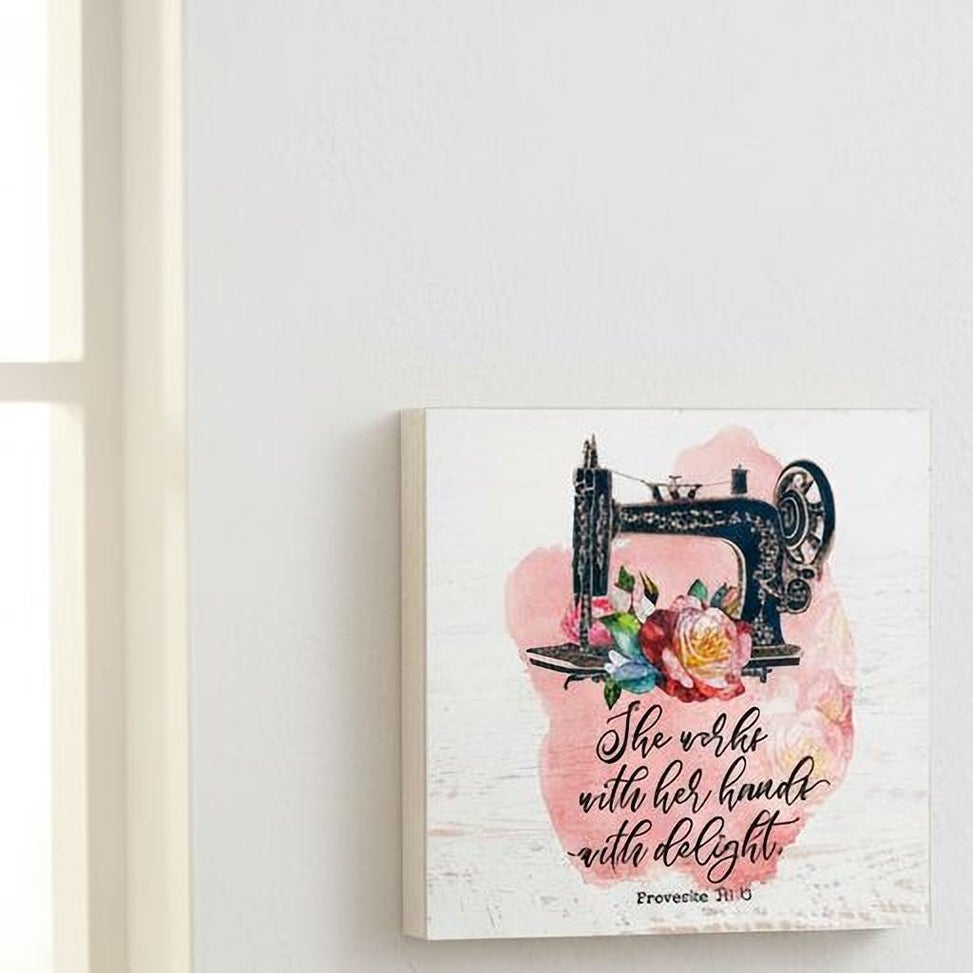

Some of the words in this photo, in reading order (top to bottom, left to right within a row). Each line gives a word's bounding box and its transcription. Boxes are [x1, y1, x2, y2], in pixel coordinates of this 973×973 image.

[596, 700, 672, 763] She
[579, 764, 647, 813] with
[653, 760, 712, 814] her
